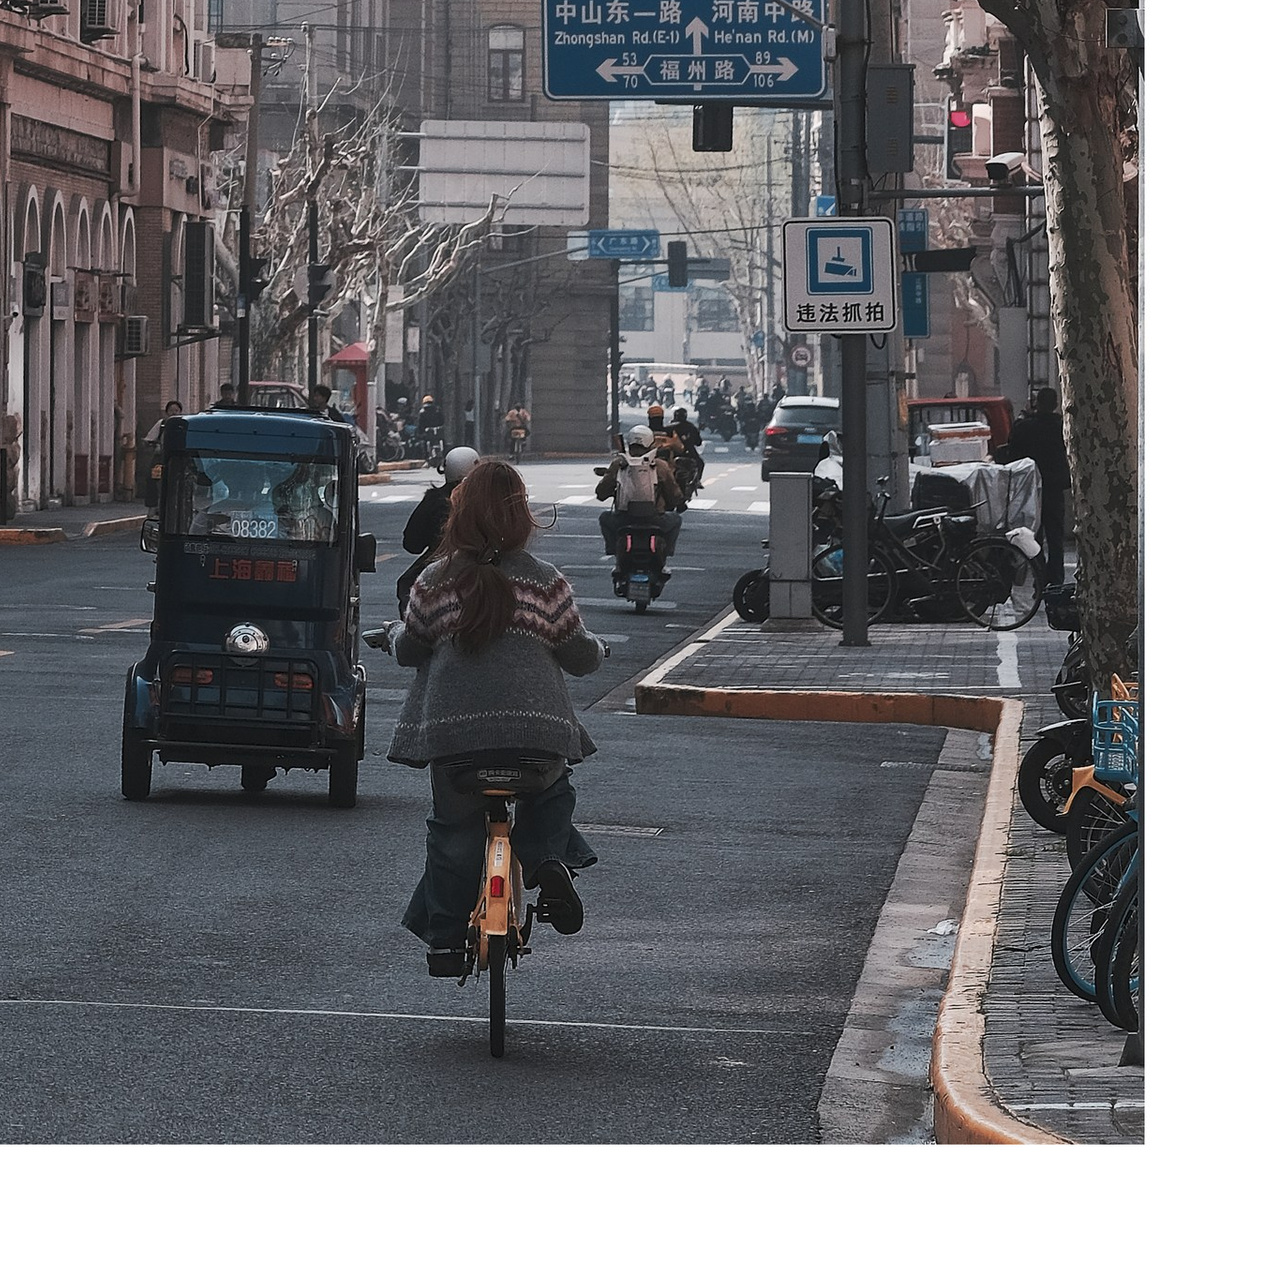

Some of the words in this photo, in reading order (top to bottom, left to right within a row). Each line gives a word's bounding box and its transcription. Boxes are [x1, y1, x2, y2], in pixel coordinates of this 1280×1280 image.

[555, 0, 682, 24] 中山东一路
[554, 31, 625, 48] Zhongshan
[714, 30, 761, 44] He'nan
[768, 30, 815, 44] Rd.(M)
[622, 52, 637, 65] 53
[755, 51, 771, 64] 89
[660, 60, 735, 80] 福州路
[623, 75, 638, 88] 70
[753, 75, 774, 88] 106
[796, 301, 884, 323] 违法抓拍
[231, 520, 276, 538] 08382
